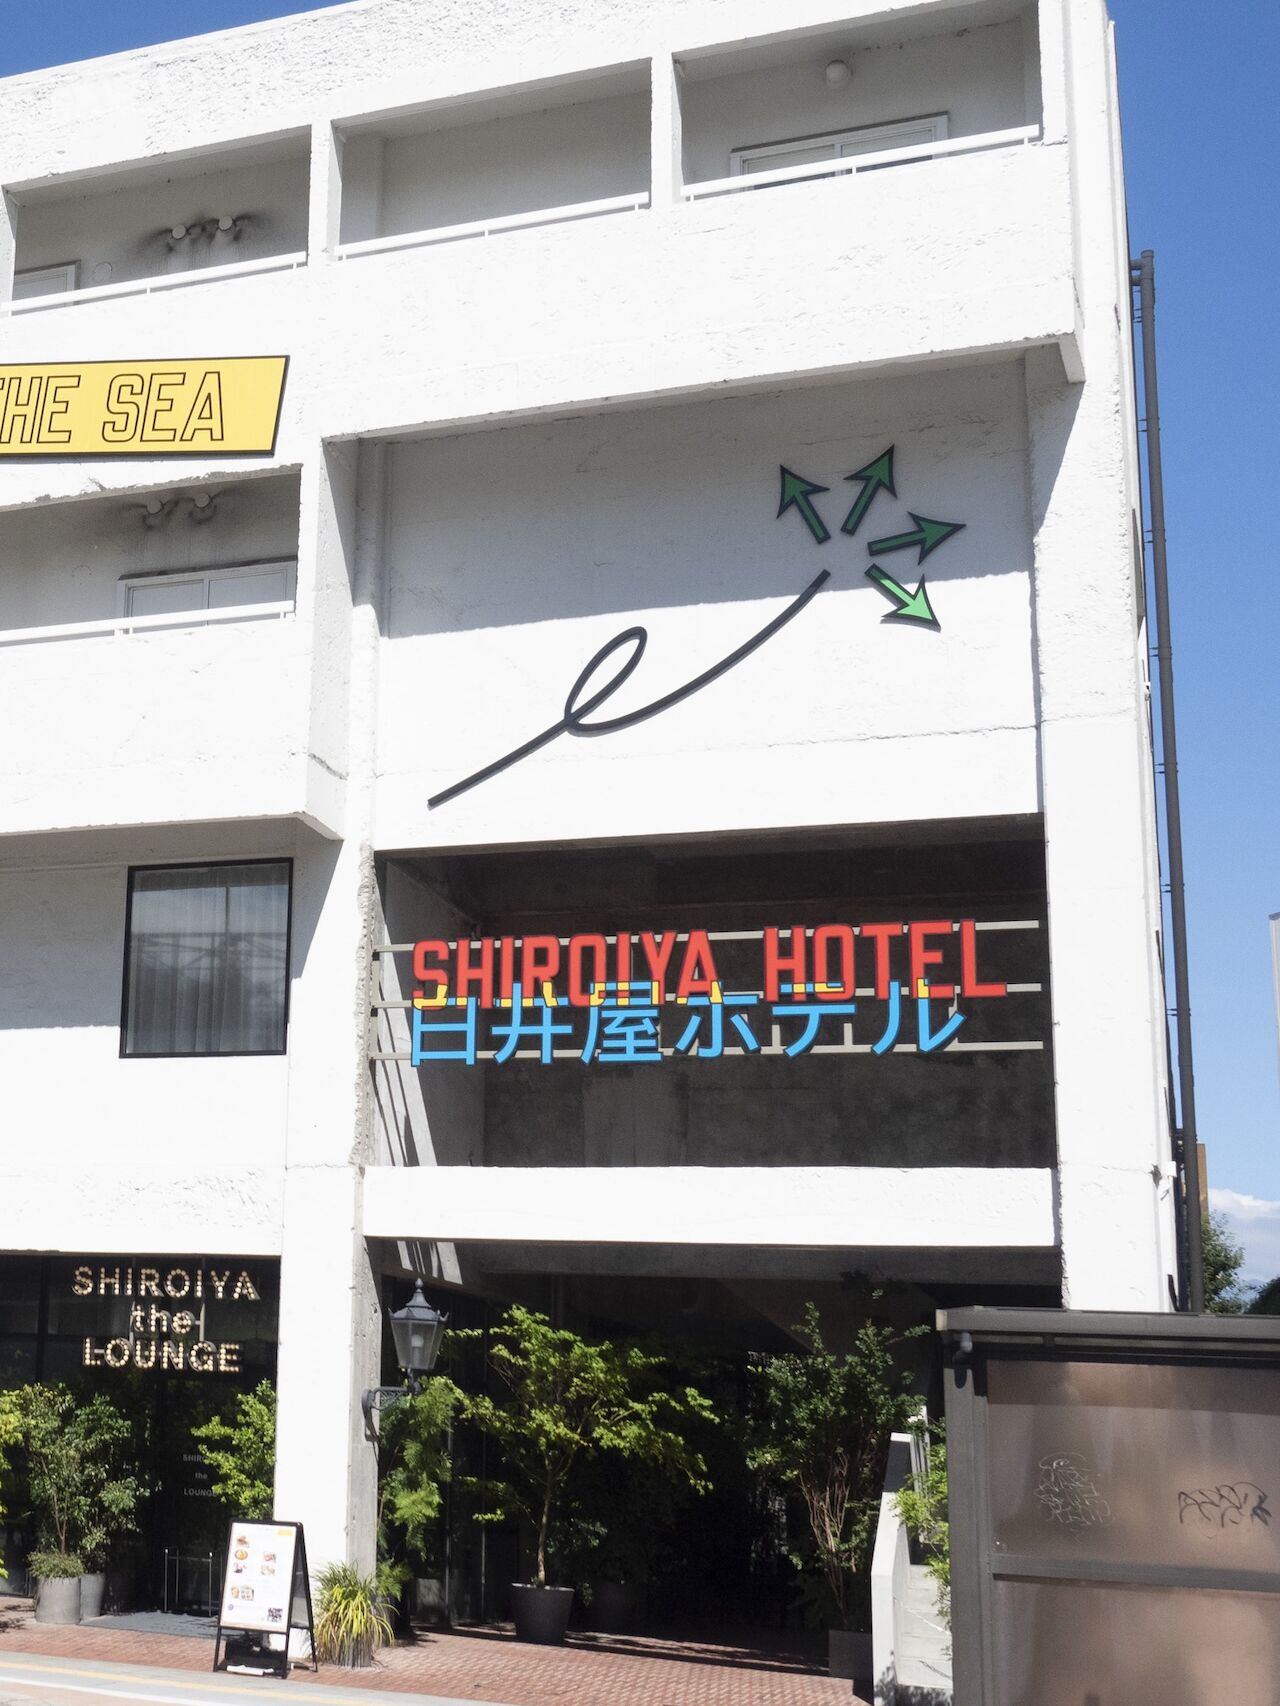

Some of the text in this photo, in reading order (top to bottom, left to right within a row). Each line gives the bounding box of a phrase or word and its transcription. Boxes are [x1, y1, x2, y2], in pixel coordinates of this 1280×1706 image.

[102, 371, 225, 443] SEA
[412, 917, 1008, 1009] SHIROIYA HOTEL
[410, 976, 967, 1067] 白井屋ホテル
[72, 1265, 261, 1301] SHIROIYA
[131, 1303, 196, 1335] the
[83, 1336, 242, 1373] LOUNGE
